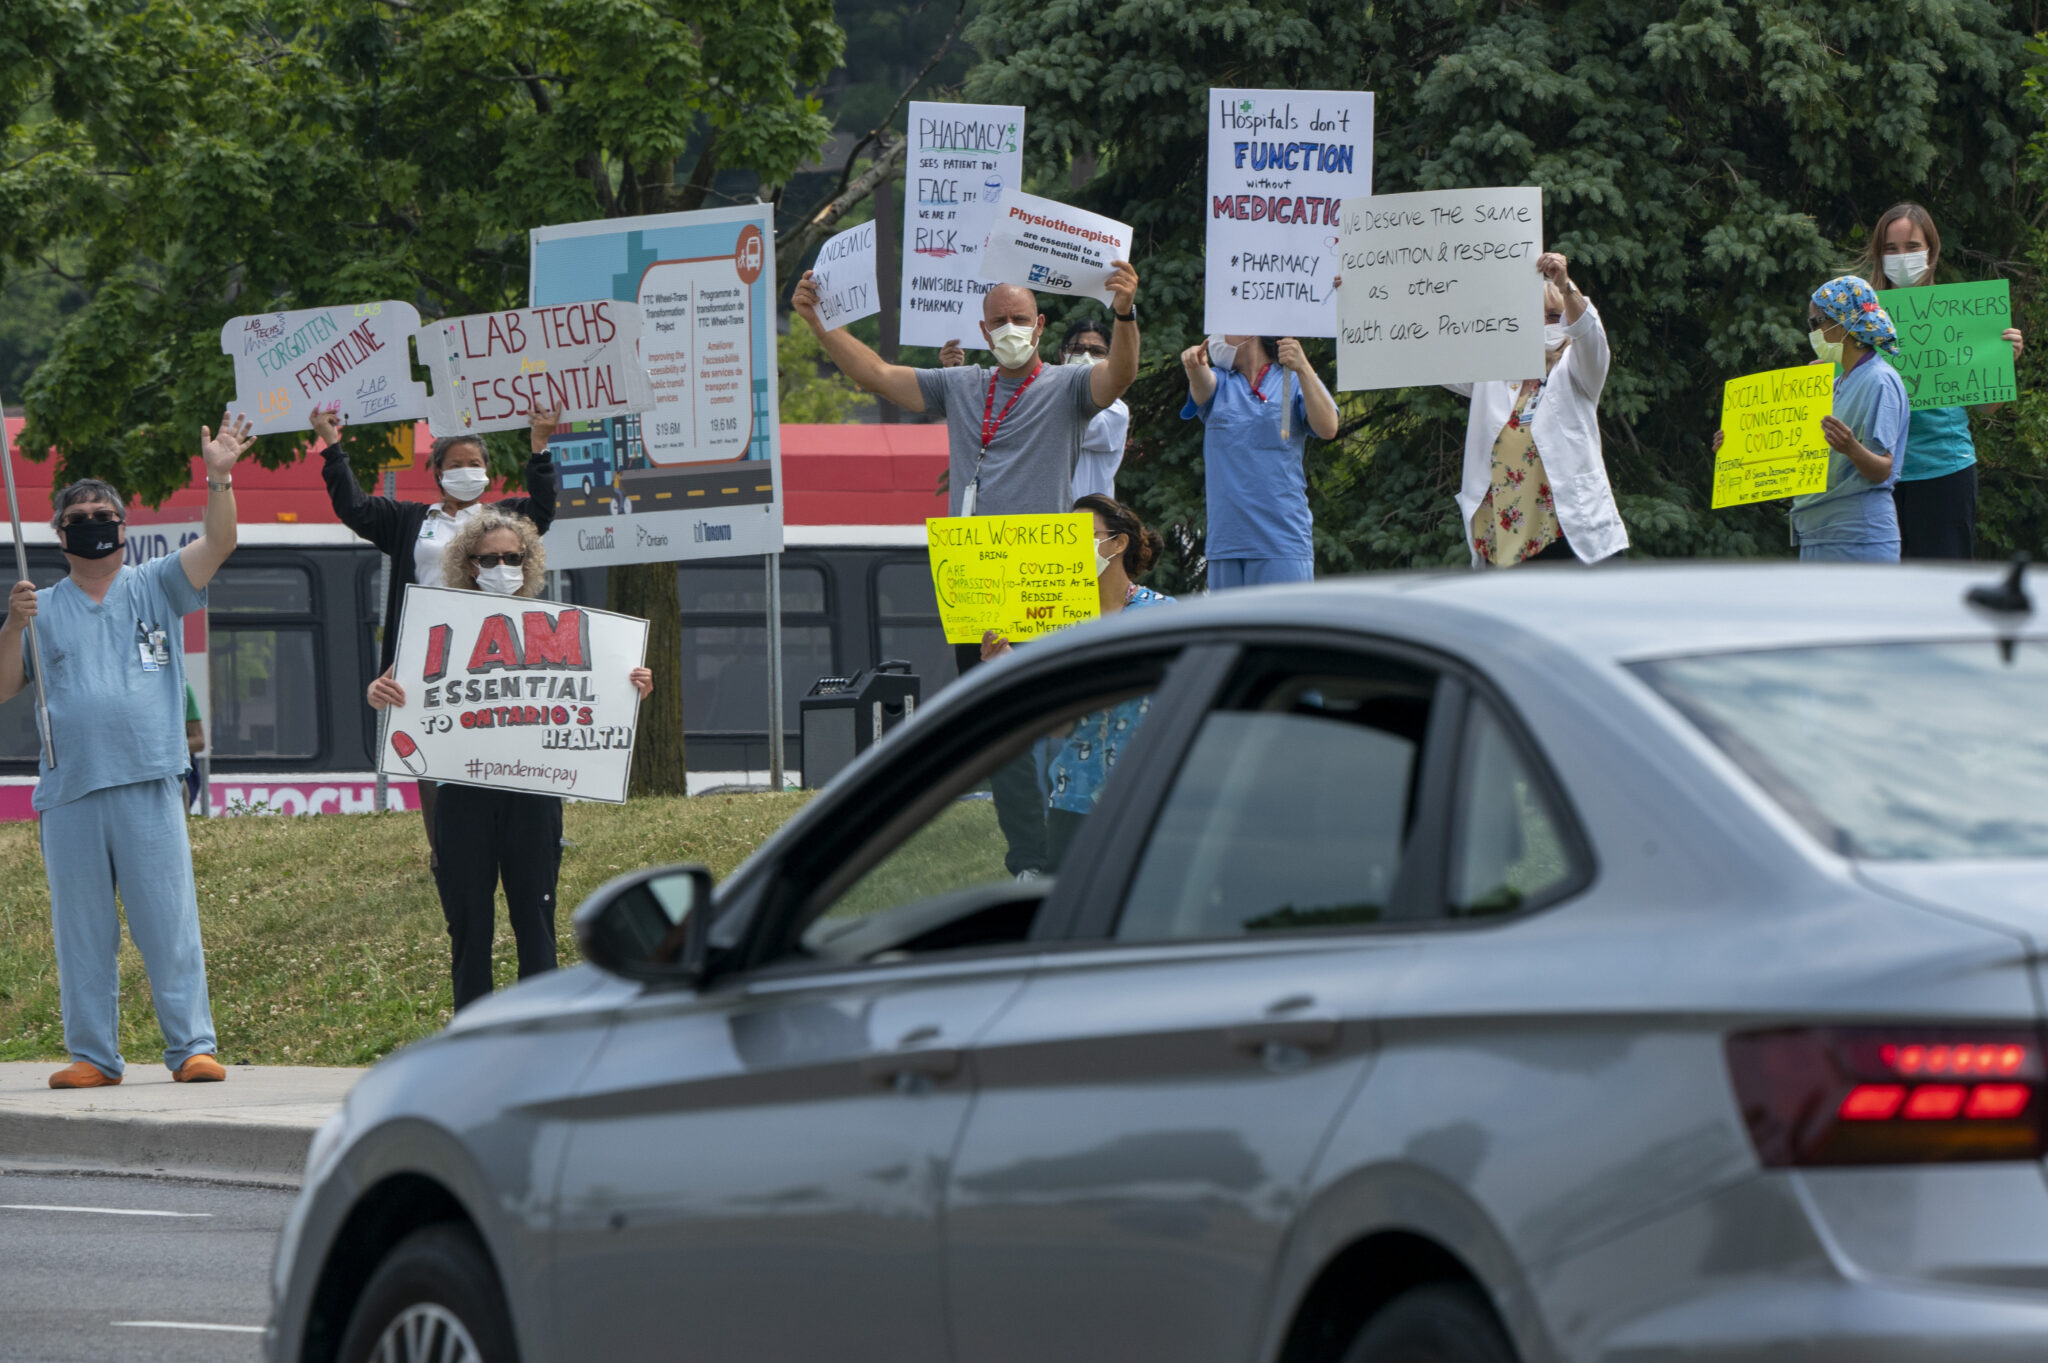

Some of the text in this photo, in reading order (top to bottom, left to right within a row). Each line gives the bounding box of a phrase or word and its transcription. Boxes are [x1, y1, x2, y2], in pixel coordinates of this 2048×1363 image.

[1221, 100, 1350, 136] Hospitals don't
[920, 118, 1006, 151] PHARMACY
[920, 158, 939, 168] SEES
[943, 159, 978, 170] PATIENT
[1233, 141, 1354, 174] FUNCTION
[919, 178, 977, 204] FACE IT!
[1246, 179, 1291, 189] without
[919, 210, 929, 219] WE
[931, 211, 944, 220] ARE
[1213, 195, 1342, 227] MEDICATIO
[1009, 206, 1121, 248] Physiotherapists
[1343, 215, 1361, 235] We
[819, 228, 871, 265] ANDEMIC
[916, 227, 958, 254] RISK
[1023, 231, 1038, 241] are
[1040, 236, 1081, 252] essential
[1083, 246, 1092, 255] to
[1015, 239, 1104, 269] modern health team
[1437, 242, 1448, 263] &
[815, 271, 830, 291] AY
[912, 275, 997, 295] #INVISIBLE FRONT
[1046, 276, 1072, 289] HPD
[1369, 278, 1458, 300] as other
[700, 288, 740, 301] Programme de
[354, 303, 381, 317] LAB
[697, 302, 744, 314] transformation de
[910, 297, 963, 314] #PHARMACY
[1909, 293, 2008, 320] WORKERS
[244, 319, 261, 331] LAB
[254, 325, 280, 339] TECHS
[460, 301, 616, 359] LAB TECHS
[656, 322, 675, 333] Project
[1341, 319, 1382, 345] health
[1390, 322, 1429, 340] care
[1944, 325, 1965, 343] OF
[257, 311, 338, 377] FORGOTTEN
[295, 318, 385, 399] FRONTLINE
[676, 351, 685, 359] the
[1883, 346, 1973, 371] OVID-19
[521, 358, 546, 374] Are
[650, 365, 679, 376] ccessibility
[700, 370, 710, 378] des
[736, 368, 743, 376] de
[356, 376, 387, 396] LAB
[651, 379, 666, 390] ublic
[731, 382, 739, 390] en
[1934, 373, 1960, 393] FOR
[1966, 367, 2014, 391] ALL
[258, 387, 291, 413] LAB
[472, 365, 627, 421] ESSENTIAL
[1725, 371, 1831, 411] SOCIAL WORKERS
[1909, 393, 1980, 408] RONTLINES
[361, 393, 397, 413] TECHS
[1740, 405, 1808, 431] CONNECTING
[656, 422, 680, 436] $19.6M
[1745, 427, 1802, 453] COVID-19
[578, 528, 615, 551] Canada
[647, 535, 668, 546] Ontario
[703, 522, 732, 542] TORONTO
[931, 520, 1078, 548] SOCIAL WORKERS
[979, 551, 1008, 561] BRING
[1020, 561, 1084, 575] COVID-19
[1021, 577, 1096, 588] PATIENTS AT THE
[1026, 605, 1091, 620] NOT FROM
[1012, 621, 1034, 633] TWO
[423, 608, 592, 684] I AM
[423, 676, 598, 709] ESSENTIAL
[420, 705, 593, 735] TO ONTARIO'S
[542, 726, 632, 750] HEALTH
[225, 787, 406, 816] MOCHA
